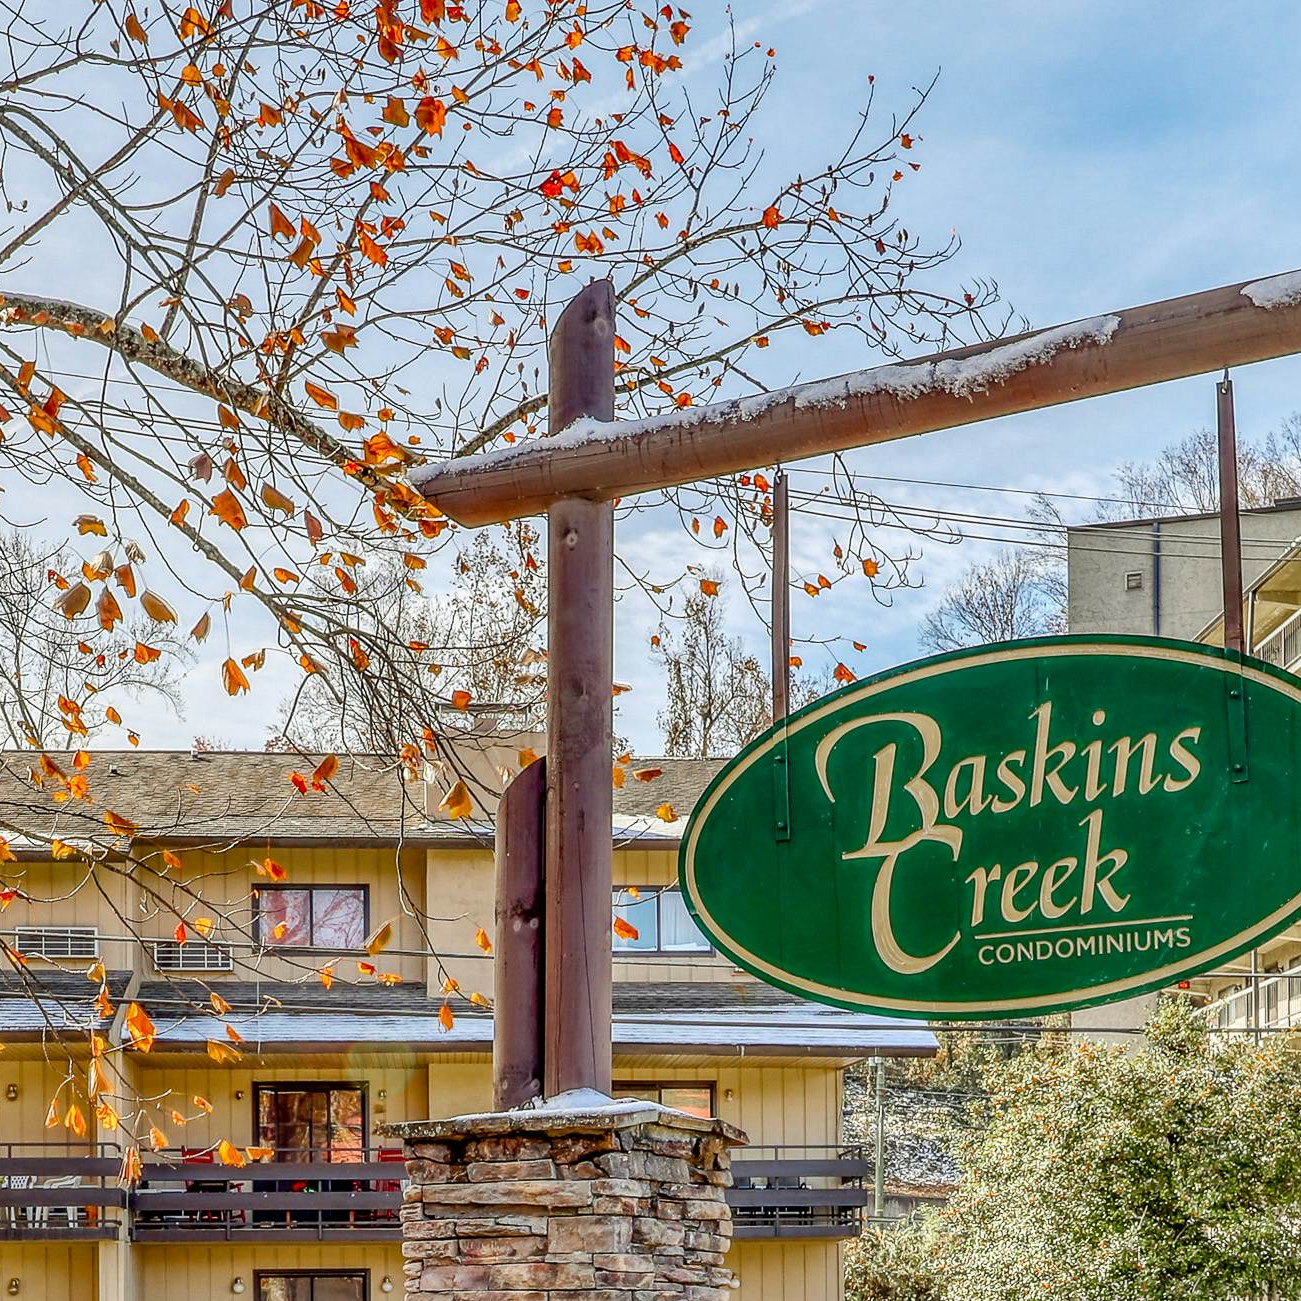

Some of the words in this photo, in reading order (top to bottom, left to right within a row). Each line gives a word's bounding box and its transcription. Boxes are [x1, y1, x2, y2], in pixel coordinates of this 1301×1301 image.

[814, 701, 1202, 860] Baskins
[871, 808, 1130, 974] Creek
[978, 926, 1192, 966] CONDOMINIUMS
